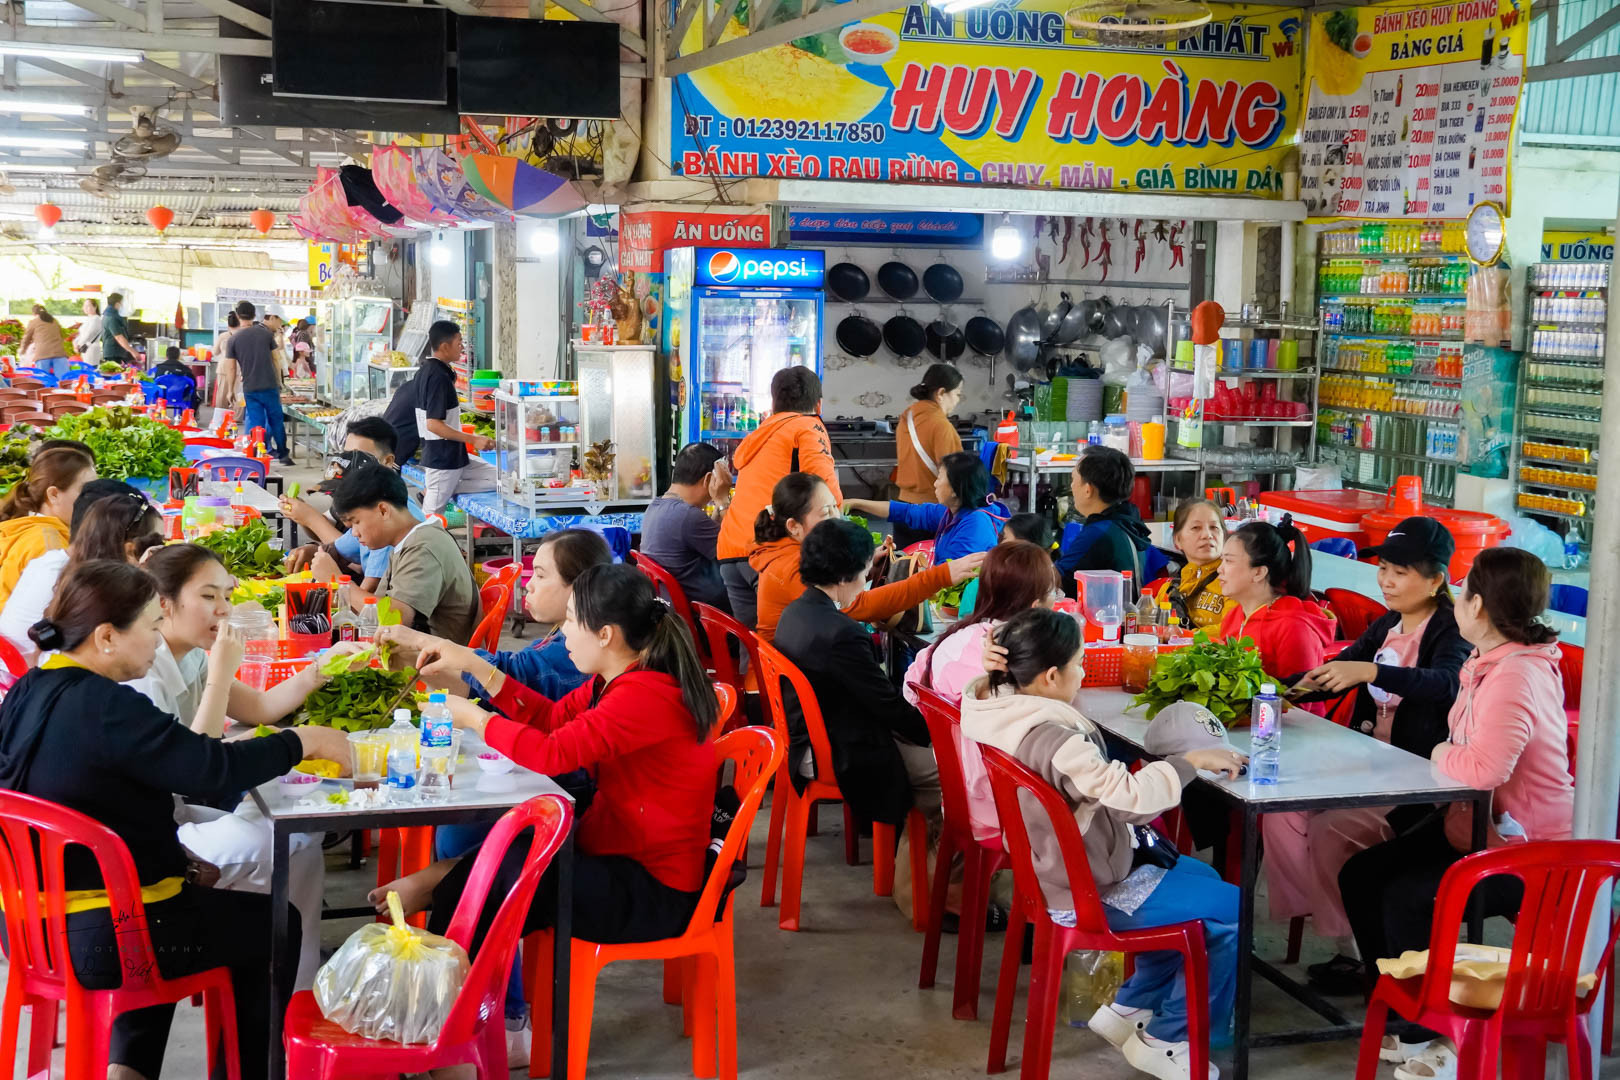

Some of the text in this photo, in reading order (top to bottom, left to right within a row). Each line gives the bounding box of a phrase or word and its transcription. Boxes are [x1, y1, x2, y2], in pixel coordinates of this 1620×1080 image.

[1430, 4, 1453, 26] HUY
[1390, 28, 1464, 60] BẢNG GIÁ
[890, 59, 1283, 146] HUY HOÀNG
[732, 117, 885, 144] 012392117850
[683, 145, 759, 177] BÁNH
[767, 148, 822, 178] XÈO
[828, 156, 881, 181] RAU
[888, 152, 958, 182] RỪNG
[1135, 162, 1176, 190] GIÁ
[1183, 163, 1238, 190] BÌNH
[674, 220, 703, 240] ĂN
[709, 219, 764, 242] UỐNG
[1560, 237, 1614, 260] UỐNG
[744, 257, 806, 281] pepsi
